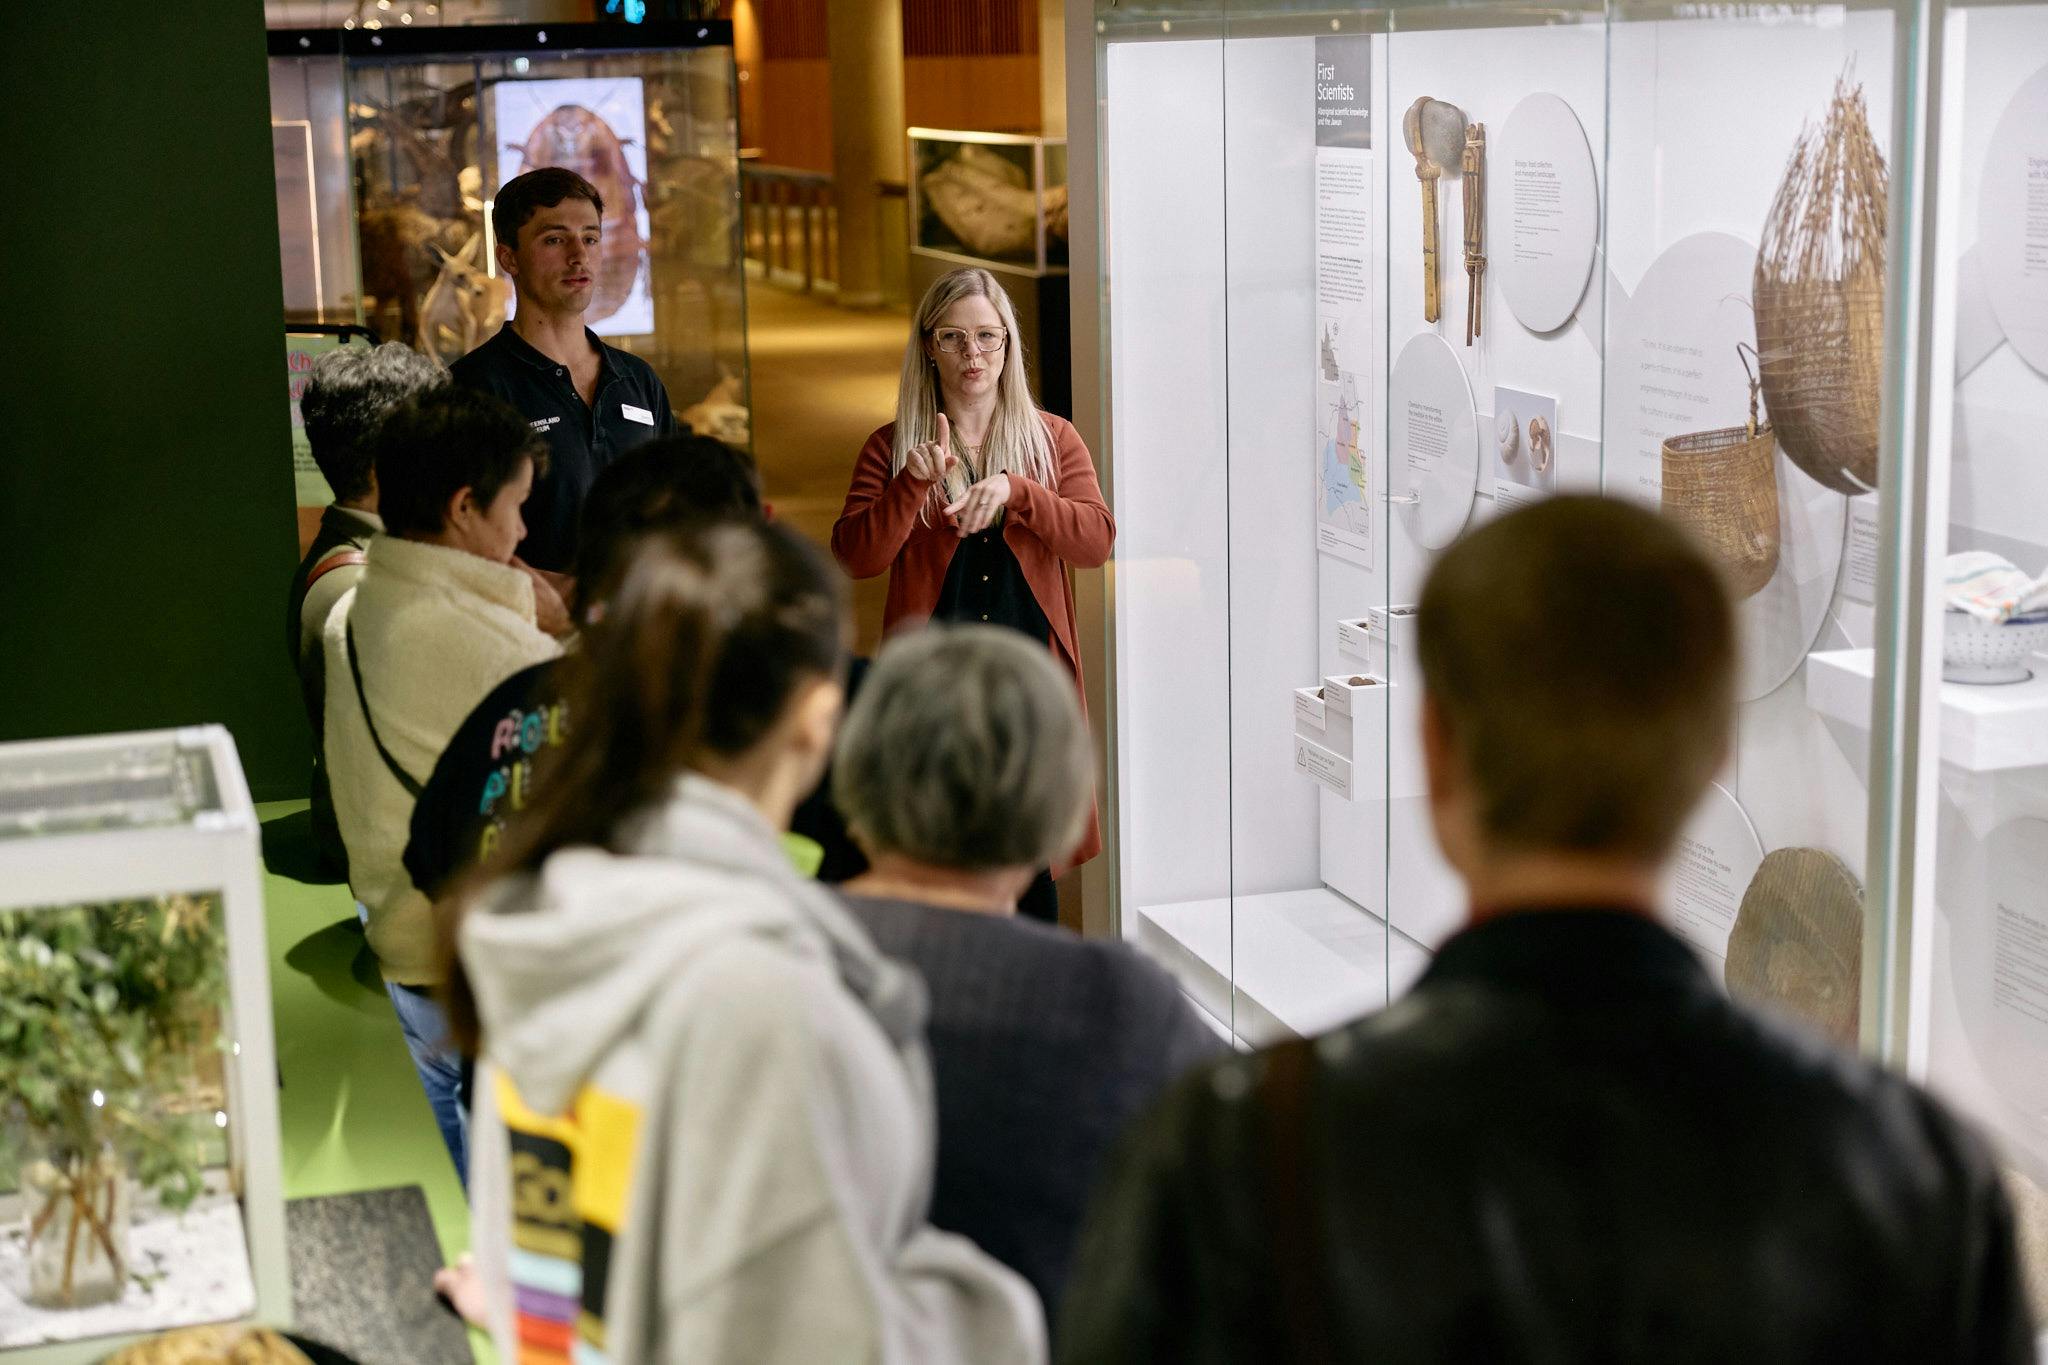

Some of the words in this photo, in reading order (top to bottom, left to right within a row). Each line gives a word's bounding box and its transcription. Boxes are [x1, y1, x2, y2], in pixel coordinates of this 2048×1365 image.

[1317, 63, 1335, 80] First
[1317, 83, 1354, 100] Scientists
[1335, 107, 1349, 116] scientific
[1349, 107, 1369, 118] knowledge
[1317, 118, 1325, 126] and
[529, 416, 560, 428] EENSLAND
